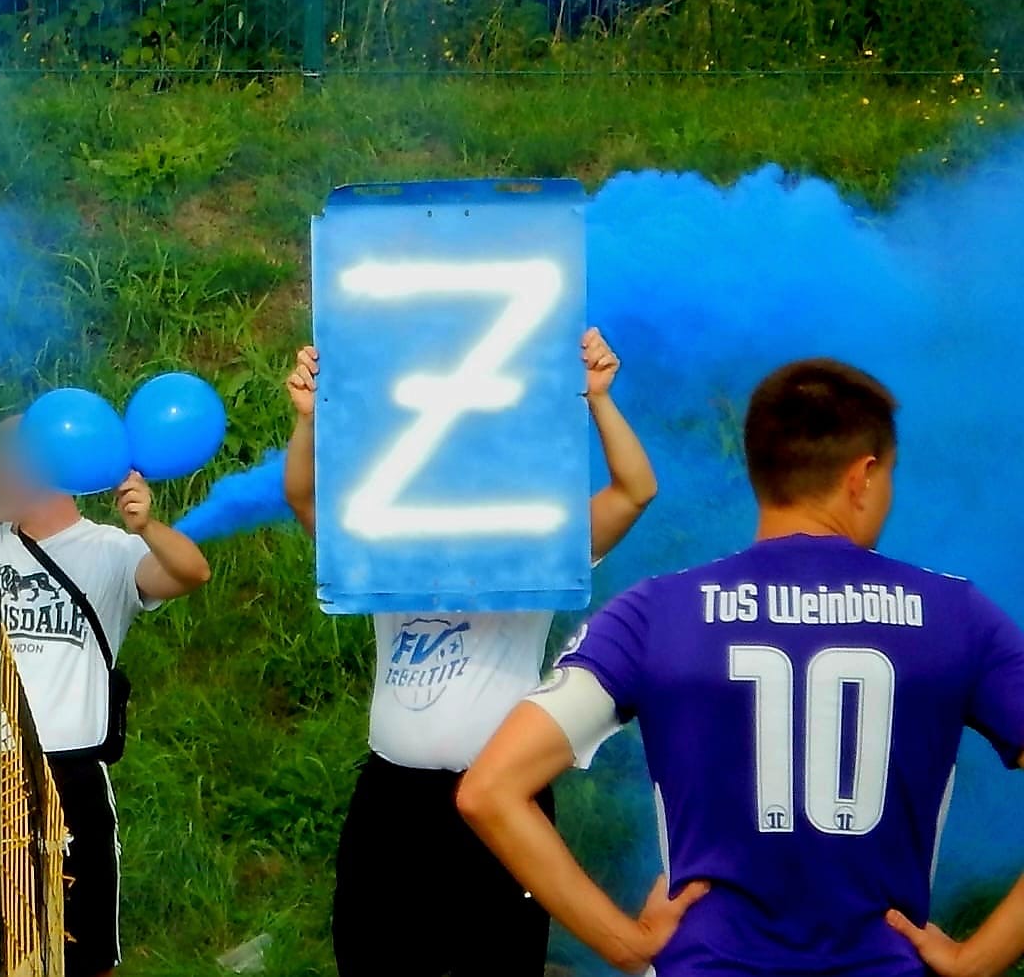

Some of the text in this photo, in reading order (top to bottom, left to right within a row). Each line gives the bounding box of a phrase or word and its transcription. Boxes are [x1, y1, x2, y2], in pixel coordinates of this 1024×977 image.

[340, 260, 563, 535] Z
[3, 601, 86, 638] SDALE
[701, 584, 923, 627] TuS Weinböhla
[729, 645, 895, 835] 10
